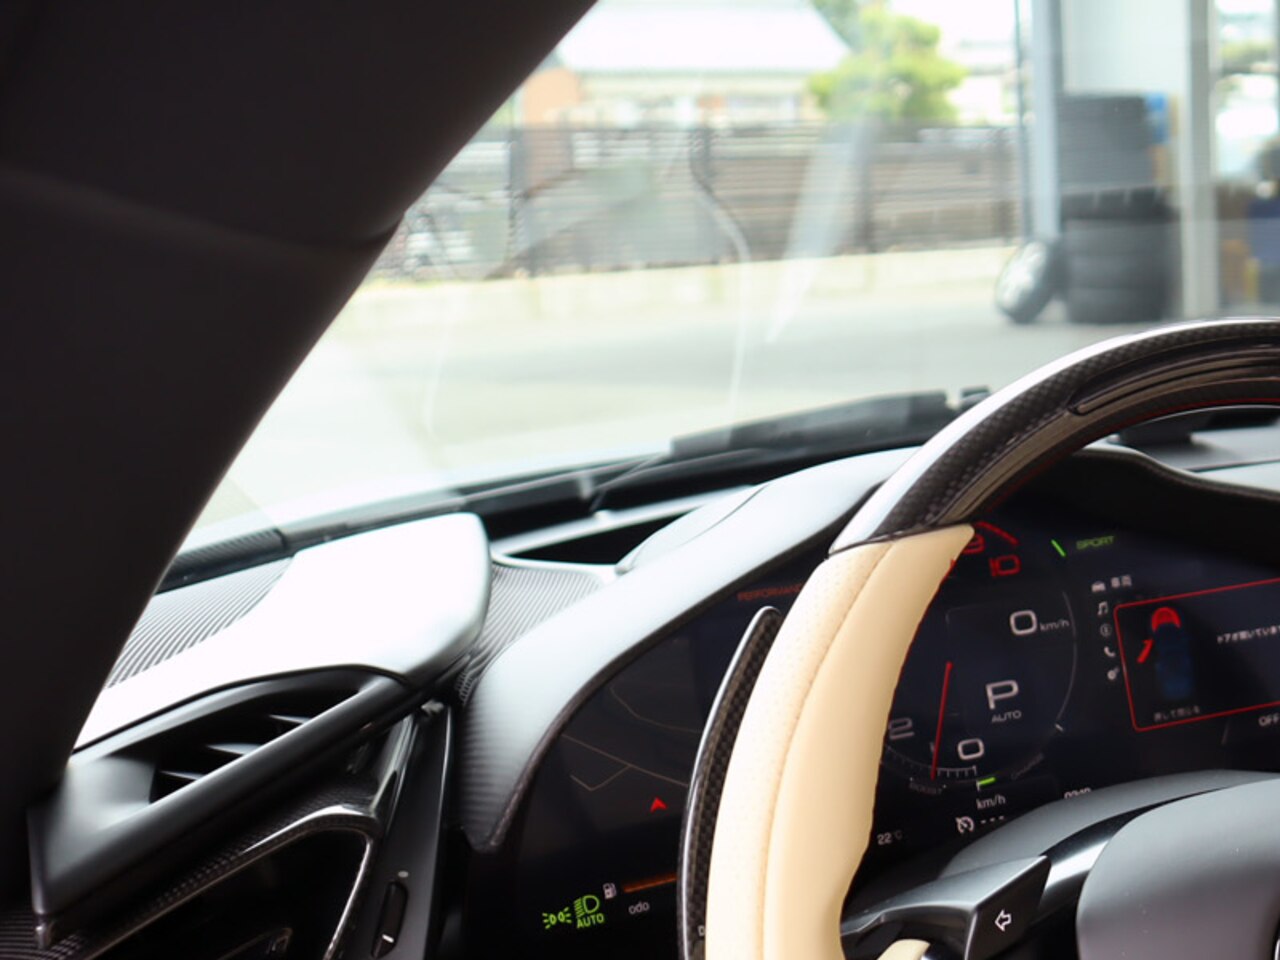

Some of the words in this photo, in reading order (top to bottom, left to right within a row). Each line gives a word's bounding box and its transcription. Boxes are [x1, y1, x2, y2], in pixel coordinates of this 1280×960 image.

[1076, 535, 1115, 551] SPORT
[988, 554, 1022, 578] 10
[1009, 609, 1037, 635] 0
[1040, 618, 1070, 632] km/h
[985, 679, 1019, 710] P
[991, 709, 1022, 723] AUTO
[1258, 712, 1280, 727] OFF
[957, 737, 985, 760] 0
[976, 793, 1006, 810] km/h
[576, 912, 604, 929] AUTO
